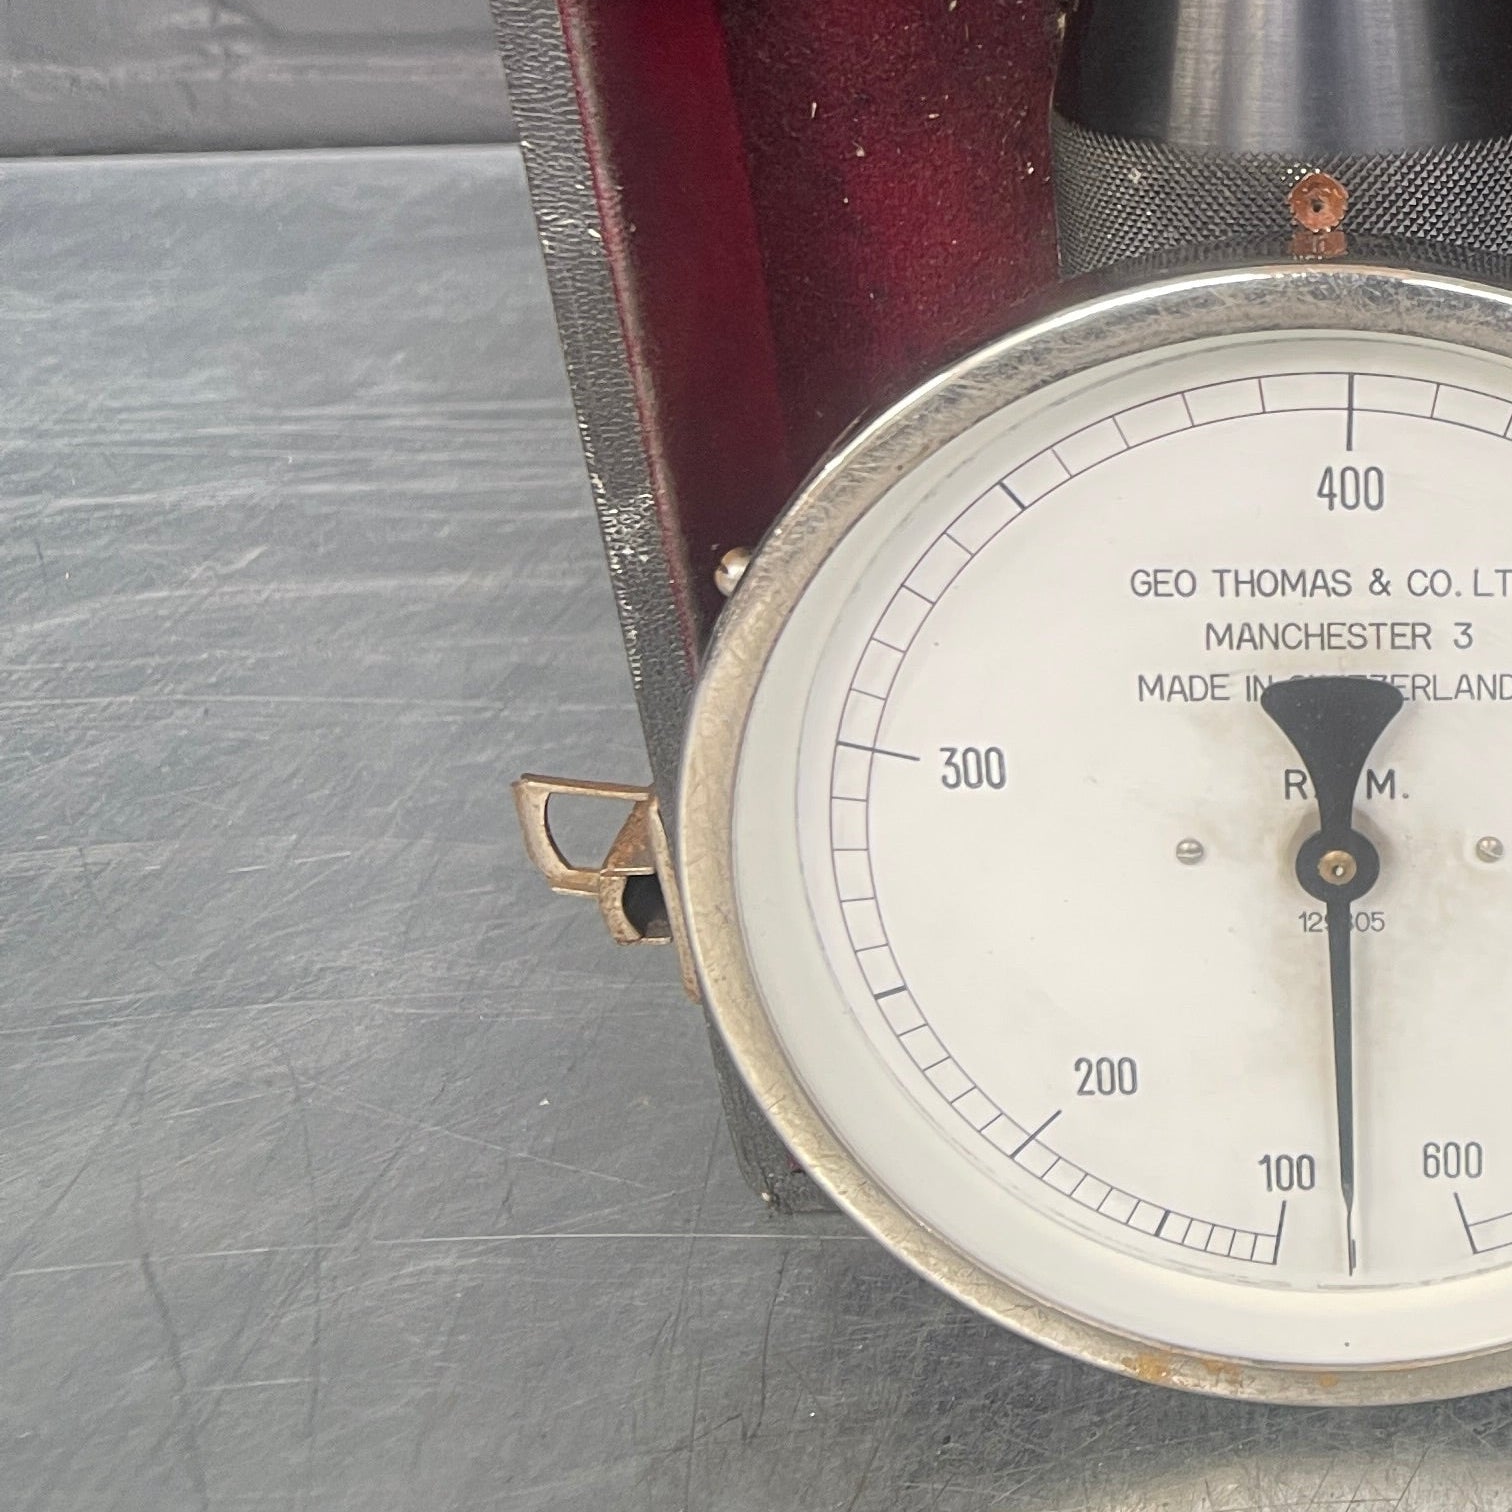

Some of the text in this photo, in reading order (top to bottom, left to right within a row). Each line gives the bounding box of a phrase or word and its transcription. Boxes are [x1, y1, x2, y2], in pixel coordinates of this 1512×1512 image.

[1317, 465, 1385, 511] 400
[1130, 568, 1197, 598] GEO
[1211, 568, 1353, 598] THOMAS
[1368, 567, 1392, 597] &
[1406, 568, 1462, 598] CO.
[1205, 621, 1474, 651] MANCHESTER 3
[1137, 673, 1231, 703] MADE
[940, 746, 1007, 790] 300
[1298, 911, 1386, 933] 1205
[1074, 1056, 1138, 1097] 200
[1257, 1153, 1316, 1193] 100
[1422, 1141, 1483, 1179] 600
